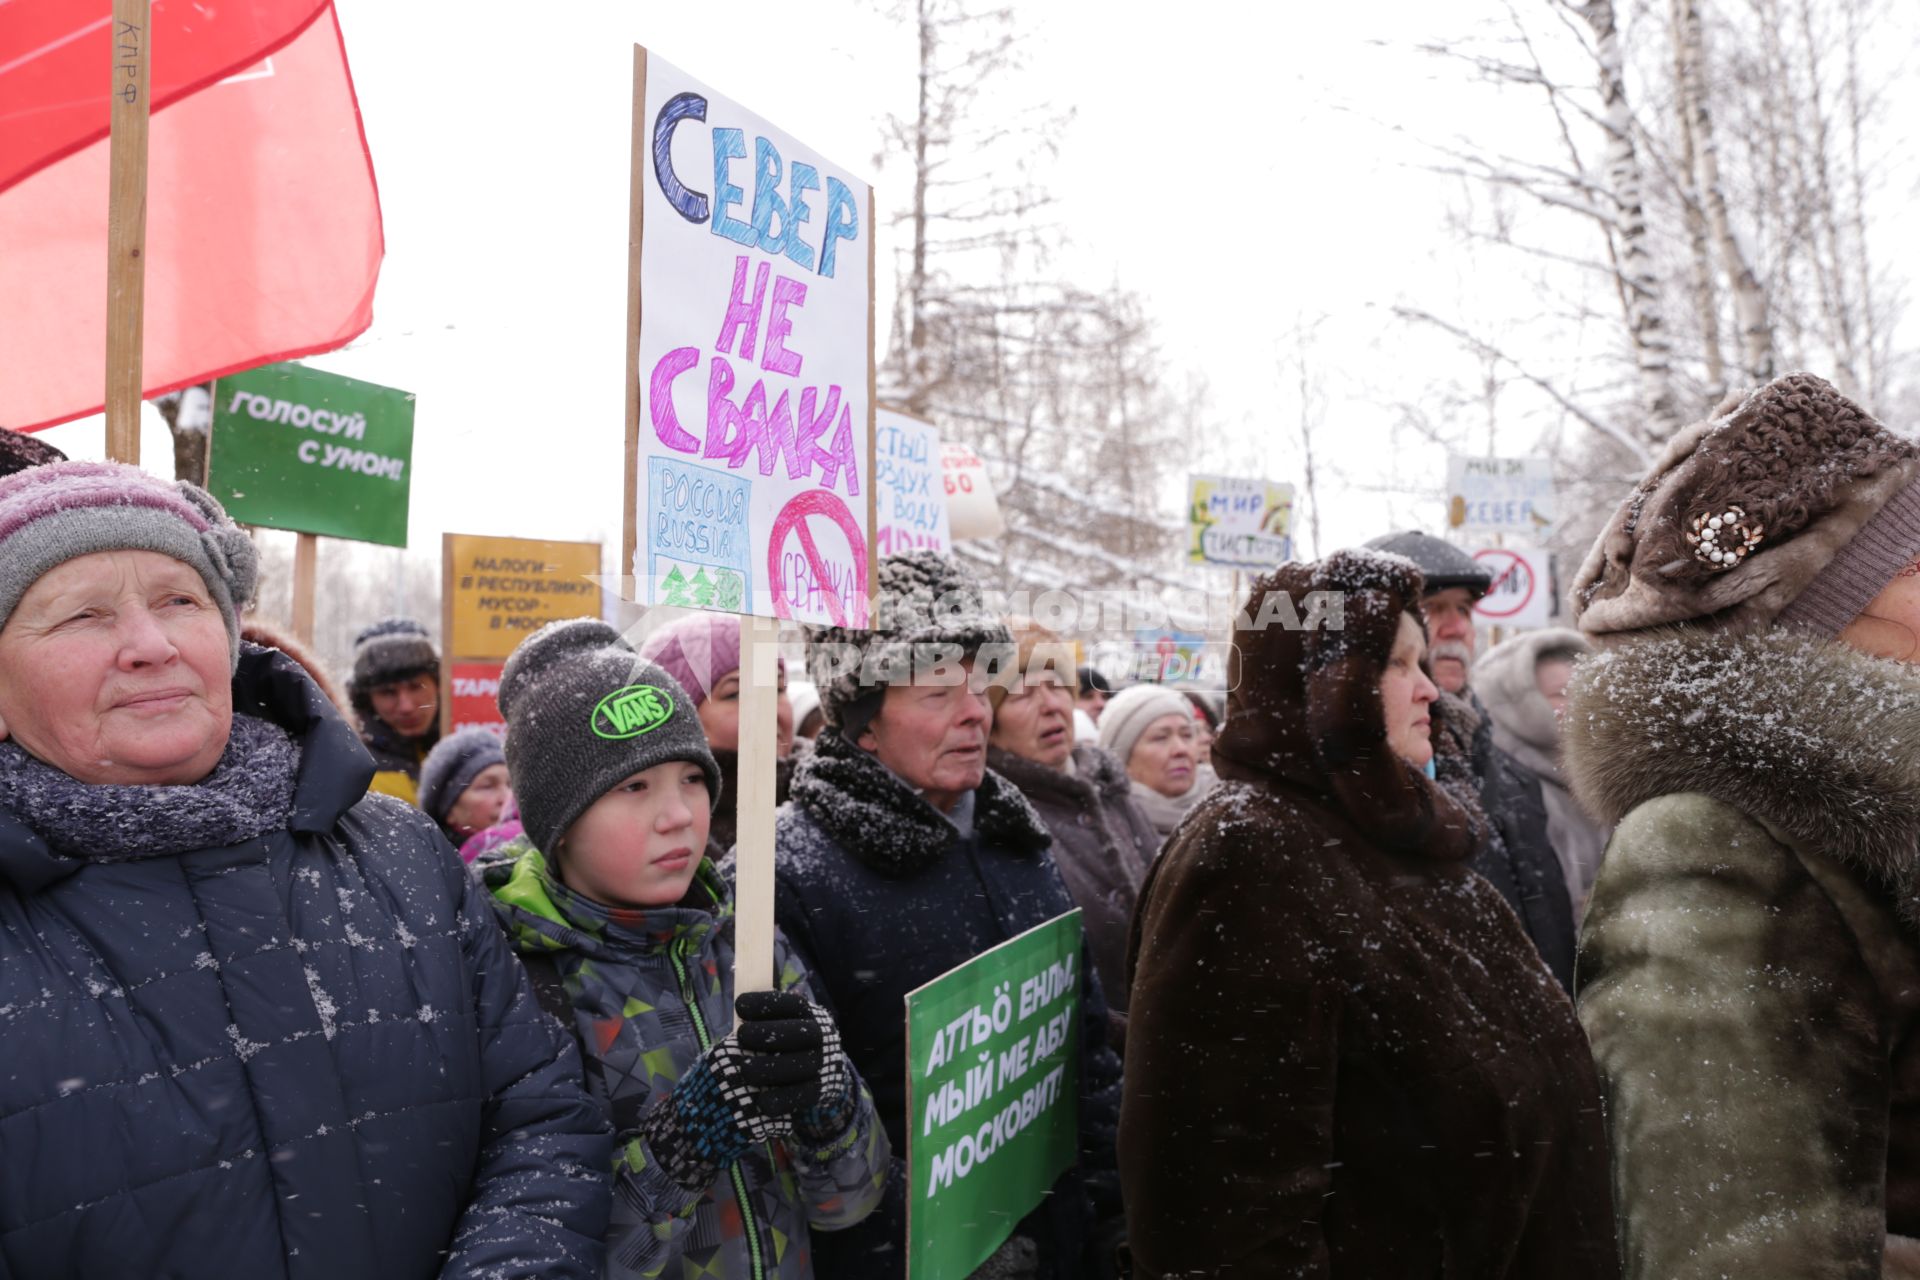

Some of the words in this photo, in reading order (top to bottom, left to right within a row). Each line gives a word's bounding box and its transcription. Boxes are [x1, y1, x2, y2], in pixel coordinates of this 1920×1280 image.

[115, 20, 141, 104] КПРФ
[715, 255, 808, 378] НЕ
[228, 390, 367, 440] ГОЛОСУЙ
[298, 440, 321, 464] С
[320, 443, 405, 482] УМОМ!
[876, 426, 928, 464] СТЫЙ
[661, 467, 745, 526] РОССИЯ
[876, 459, 932, 496] ОЗДУХ
[894, 494, 940, 531] ВОДУ
[1210, 494, 1263, 515] МИР
[1466, 500, 1534, 524] СЕВЕР
[656, 511, 732, 559] RUSSIA
[461, 576, 473, 591] В
[473, 556, 545, 573] НАЛОГИ
[478, 597, 540, 612] МУСОР
[490, 615, 502, 630] В
[506, 616, 552, 630] МОС
[600, 688, 665, 734] VANS
[923, 1050, 994, 1137] МЫЙ
[997, 1035, 1031, 1092] МЕ
[1030, 1005, 1071, 1067] АБУ
[926, 1063, 1065, 1198] МОСКОВИТ!
